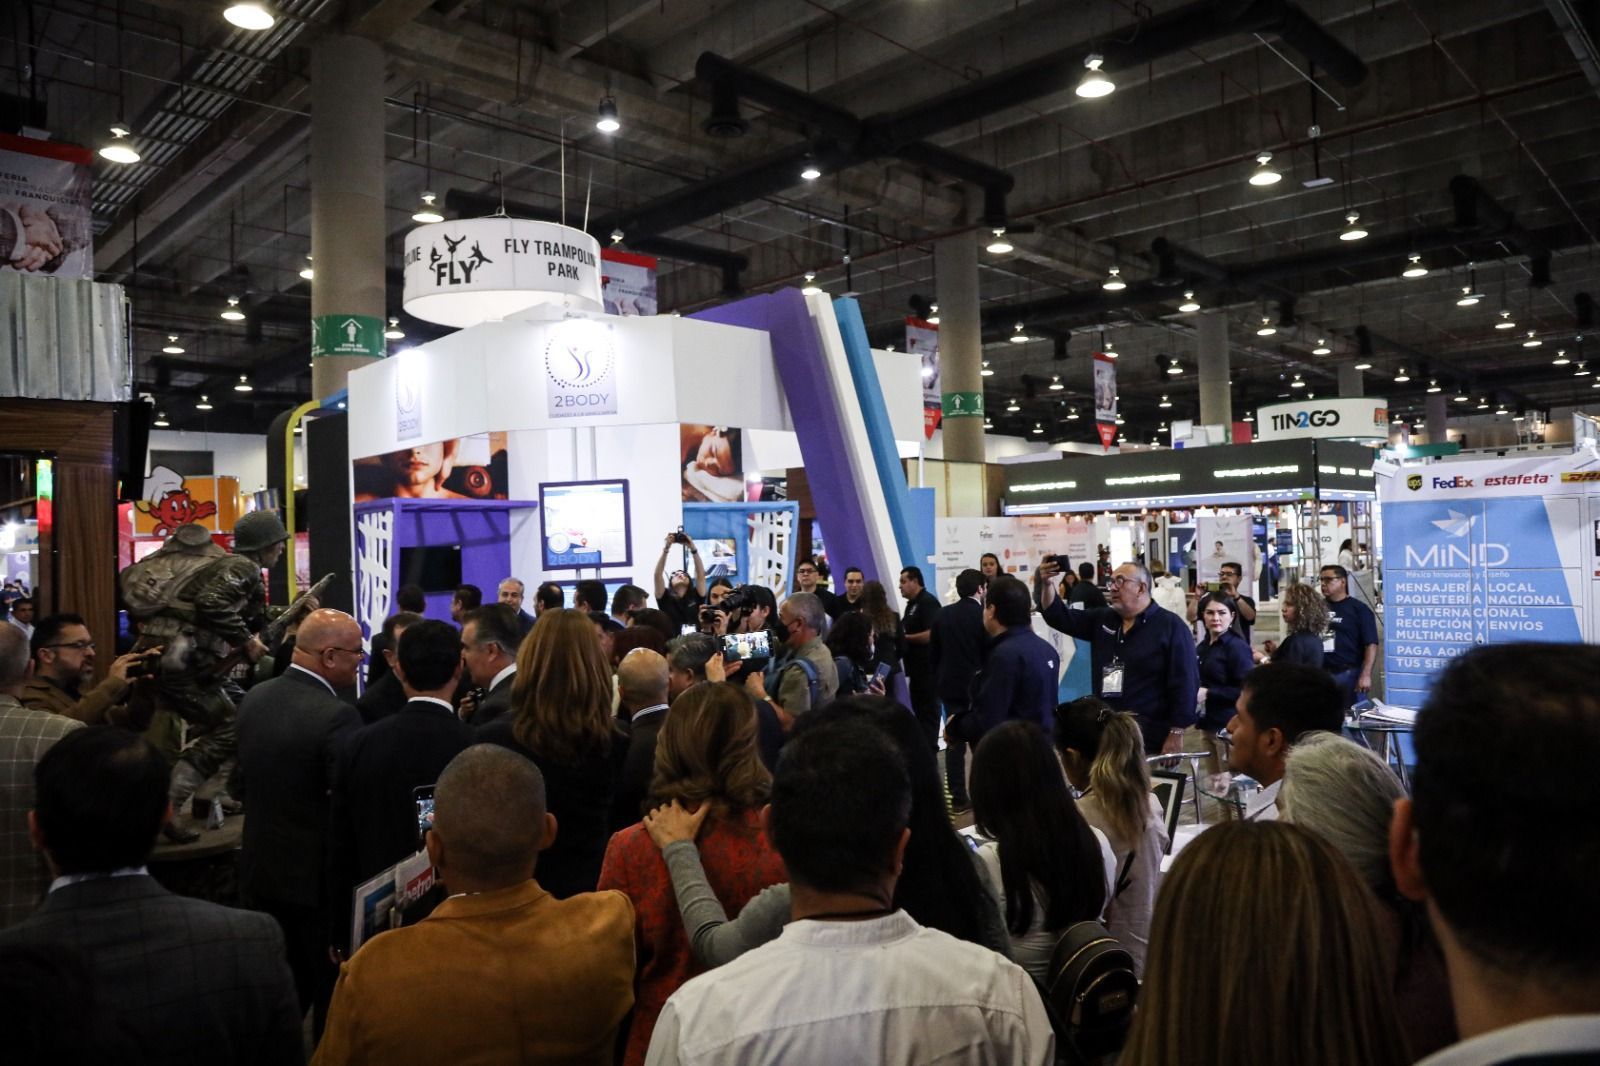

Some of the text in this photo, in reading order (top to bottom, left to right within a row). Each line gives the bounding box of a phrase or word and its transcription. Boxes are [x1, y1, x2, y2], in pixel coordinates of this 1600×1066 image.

[504, 238, 529, 254] FLY
[436, 260, 476, 287] FLY
[547, 261, 579, 280] PARK
[554, 393, 609, 408] 2BODY
[1271, 409, 1340, 431] TIN2GO
[1432, 476, 1474, 489] FedEx
[1484, 474, 1549, 486] estafeta
[1482, 570, 1510, 579] Dseño
[1396, 581, 1536, 593] MENSAJERÍA LOCAL
[1396, 593, 1564, 605] PAQUETERÍA NACIONAL
[1397, 607, 1529, 618] E INTERNACIONAL
[1396, 618, 1544, 631] RECEPCIÓN Y ENVIOS
[1396, 631, 1485, 645] MULTIMARCA
[1397, 646, 1432, 656] PAGA
[1396, 659, 1421, 668] TUS
